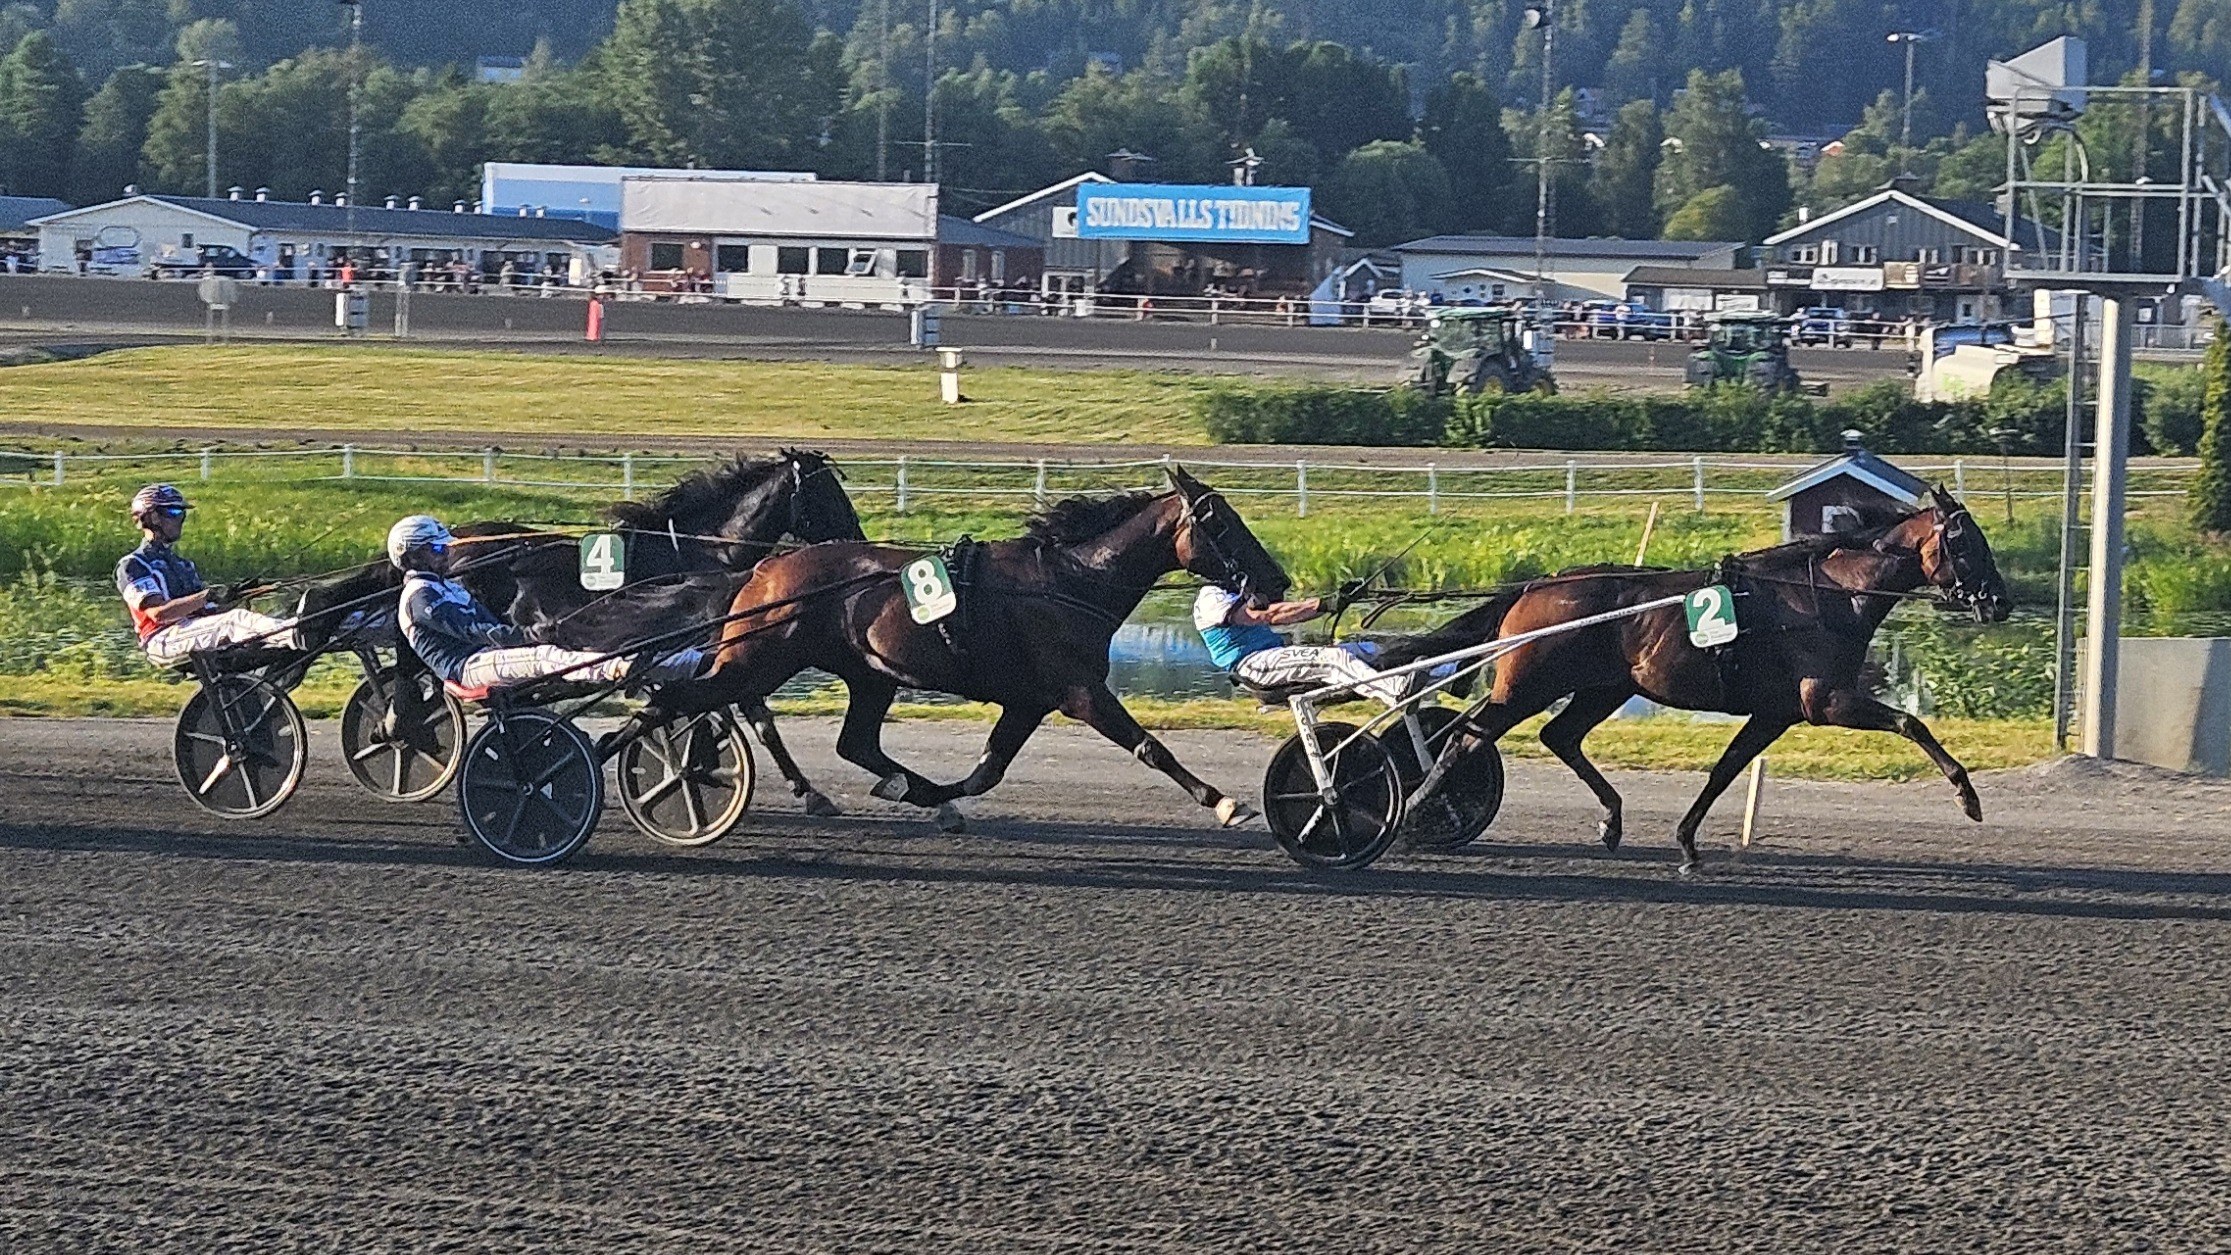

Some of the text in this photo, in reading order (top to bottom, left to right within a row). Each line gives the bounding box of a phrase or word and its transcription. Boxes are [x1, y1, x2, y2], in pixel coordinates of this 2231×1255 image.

[1086, 197, 1213, 229] SUNDSVALLS
[586, 535, 615, 574] 4
[908, 560, 943, 604] 8
[1693, 588, 1725, 632] 2
[1280, 648, 1319, 659] SVEA
